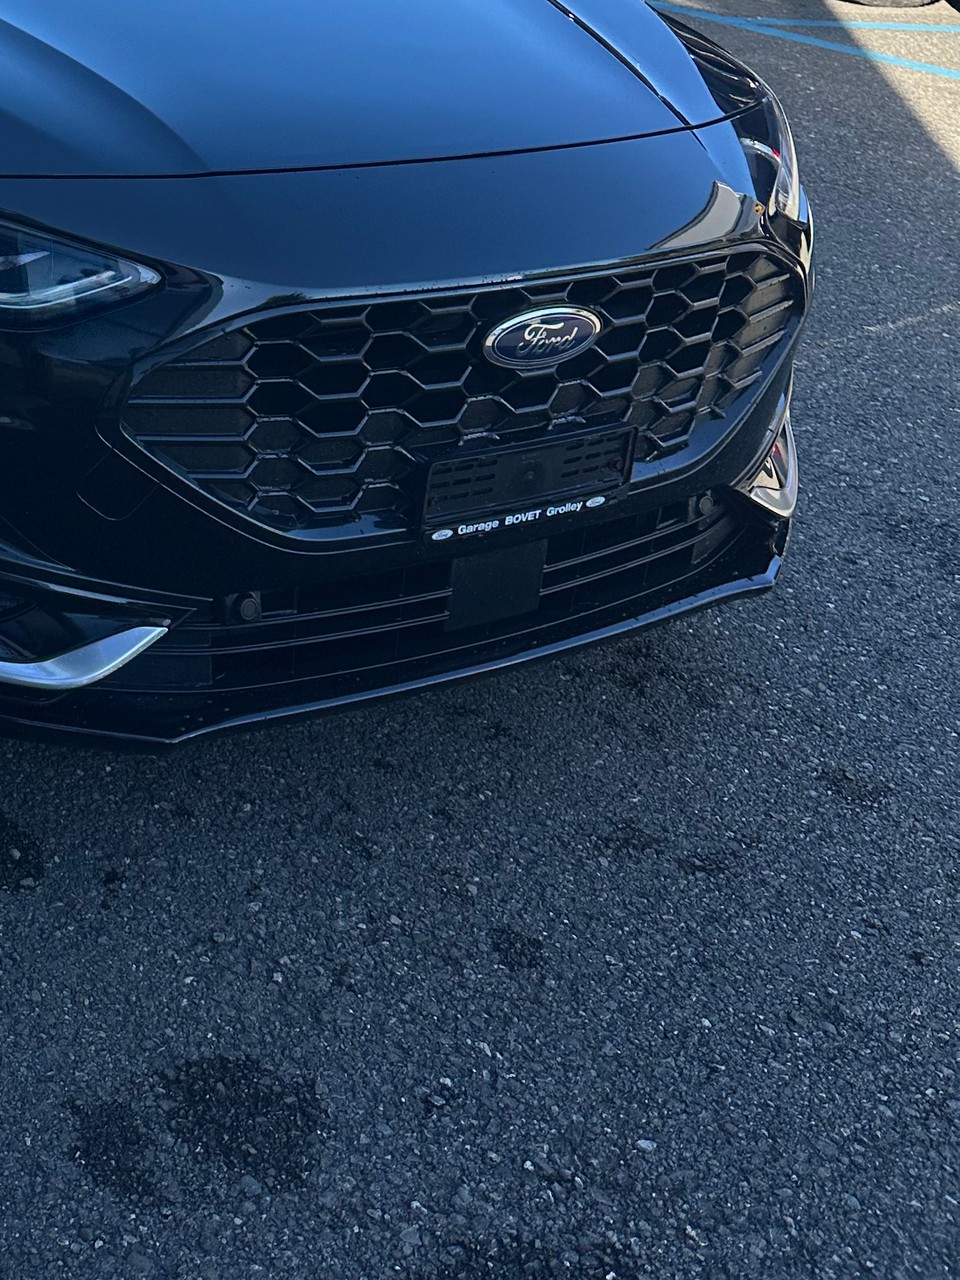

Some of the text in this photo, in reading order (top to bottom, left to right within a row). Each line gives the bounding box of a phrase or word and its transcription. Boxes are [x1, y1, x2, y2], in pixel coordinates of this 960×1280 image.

[515, 322, 579, 355] Ford
[457, 520, 499, 535] Garage
[505, 510, 542, 525] BOVET
[546, 501, 583, 516] Grolley
